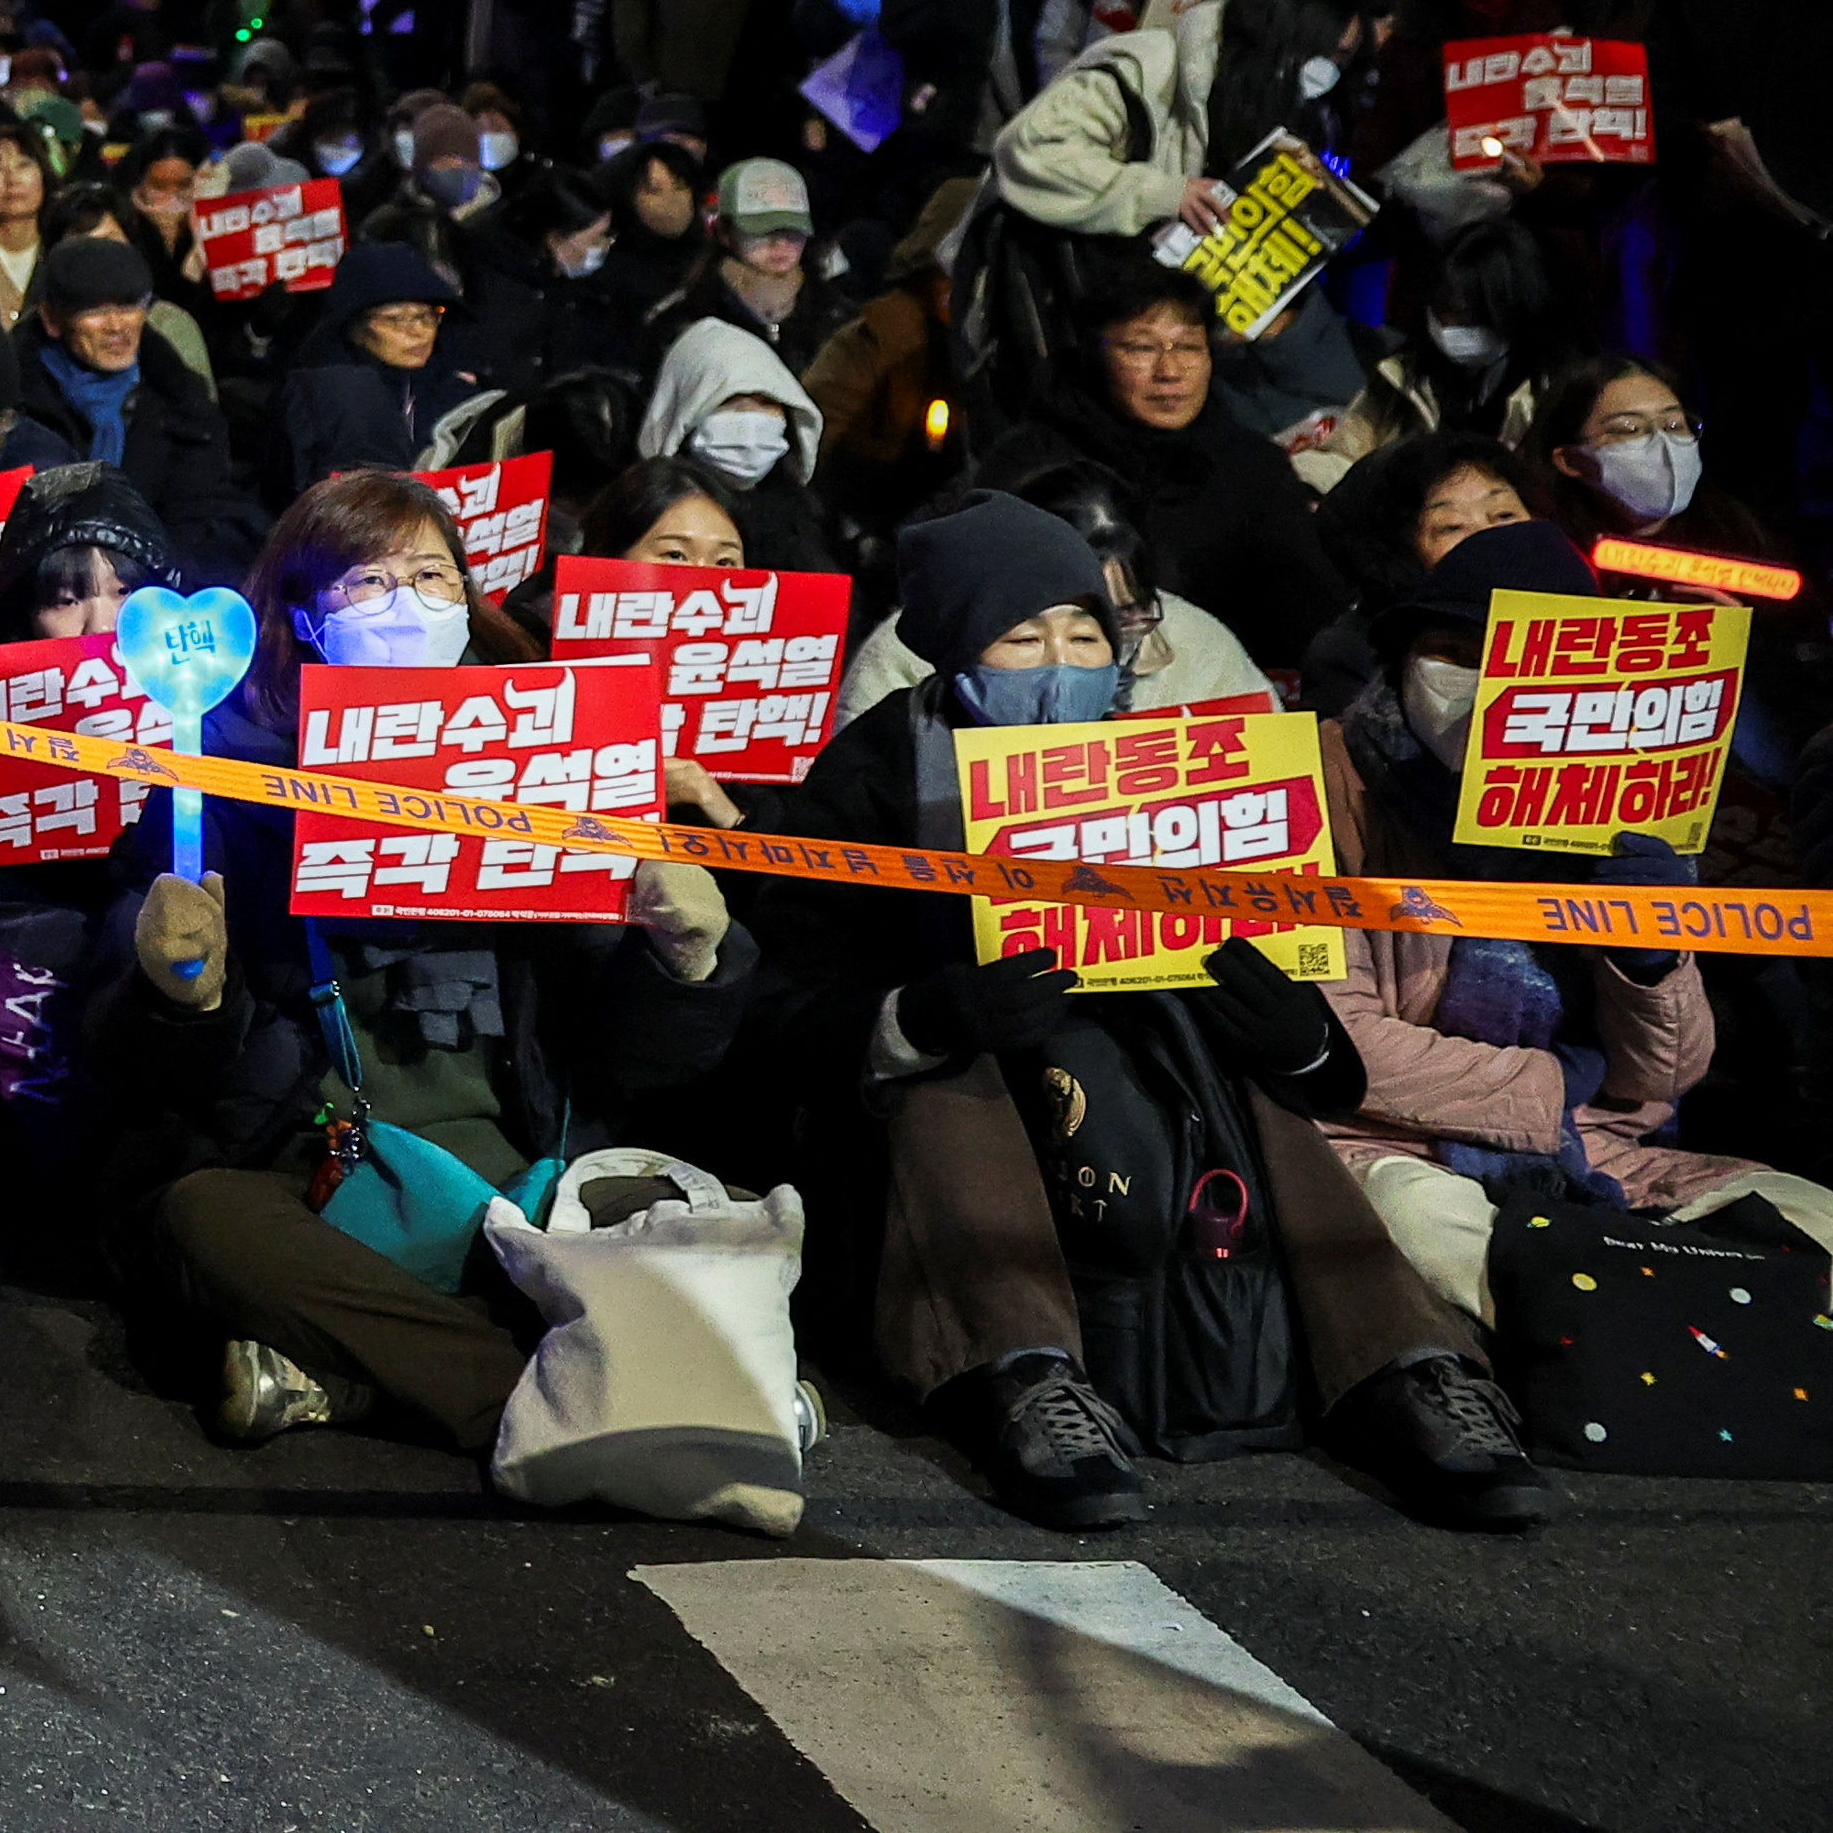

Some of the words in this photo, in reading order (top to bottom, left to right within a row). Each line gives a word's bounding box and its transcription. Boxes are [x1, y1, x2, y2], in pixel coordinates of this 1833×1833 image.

[555, 571, 779, 640] 내란수괴
[164, 619, 216, 665] 탄핵
[668, 633, 840, 696] 윤석열
[1484, 607, 1716, 678] 내란동조
[302, 666, 577, 767] 내란수괴
[694, 691, 831, 756] 탄핵!
[1502, 678, 1725, 753] 국민의힘
[260, 773, 358, 810] LINE
[441, 738, 657, 813] 윤석열
[970, 716, 1250, 821] 내란동조
[1475, 746, 1723, 828] 해체하라!
[378, 789, 533, 833] POLICE
[1009, 788, 1289, 869] 국민의힘
[295, 832, 461, 899] 즉각
[902, 853, 976, 886] 선을
[998, 862, 1034, 890] 이
[1156, 873, 1365, 919] 질서유지선
[1539, 897, 1636, 933] LINE
[1657, 899, 1815, 941] POLICE
